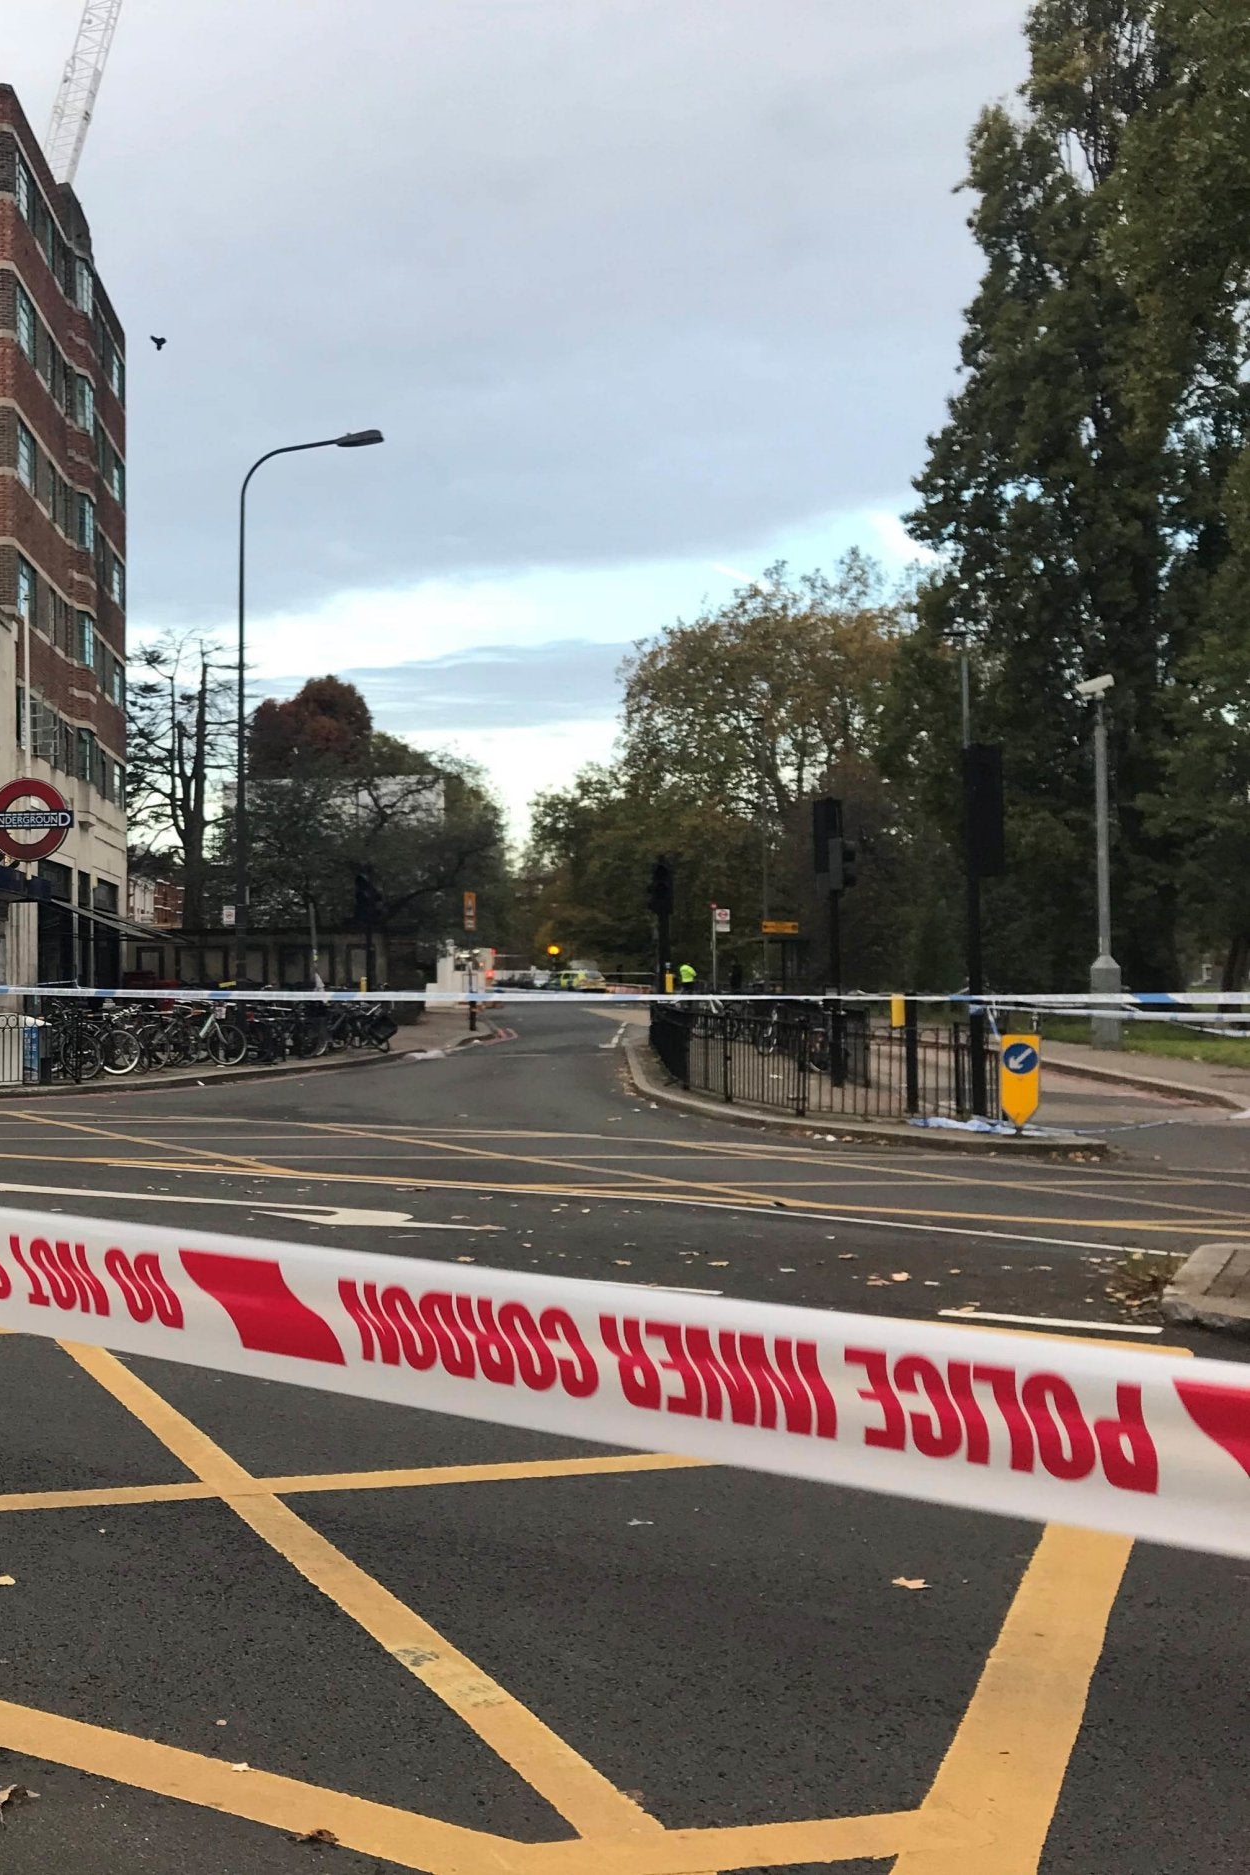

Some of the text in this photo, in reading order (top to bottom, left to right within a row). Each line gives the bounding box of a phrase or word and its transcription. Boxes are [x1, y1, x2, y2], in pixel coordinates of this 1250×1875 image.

[8, 1233, 111, 1318] NOT
[103, 1247, 185, 1330] DO
[337, 1277, 1160, 1495] POLICE INNER CORDON
